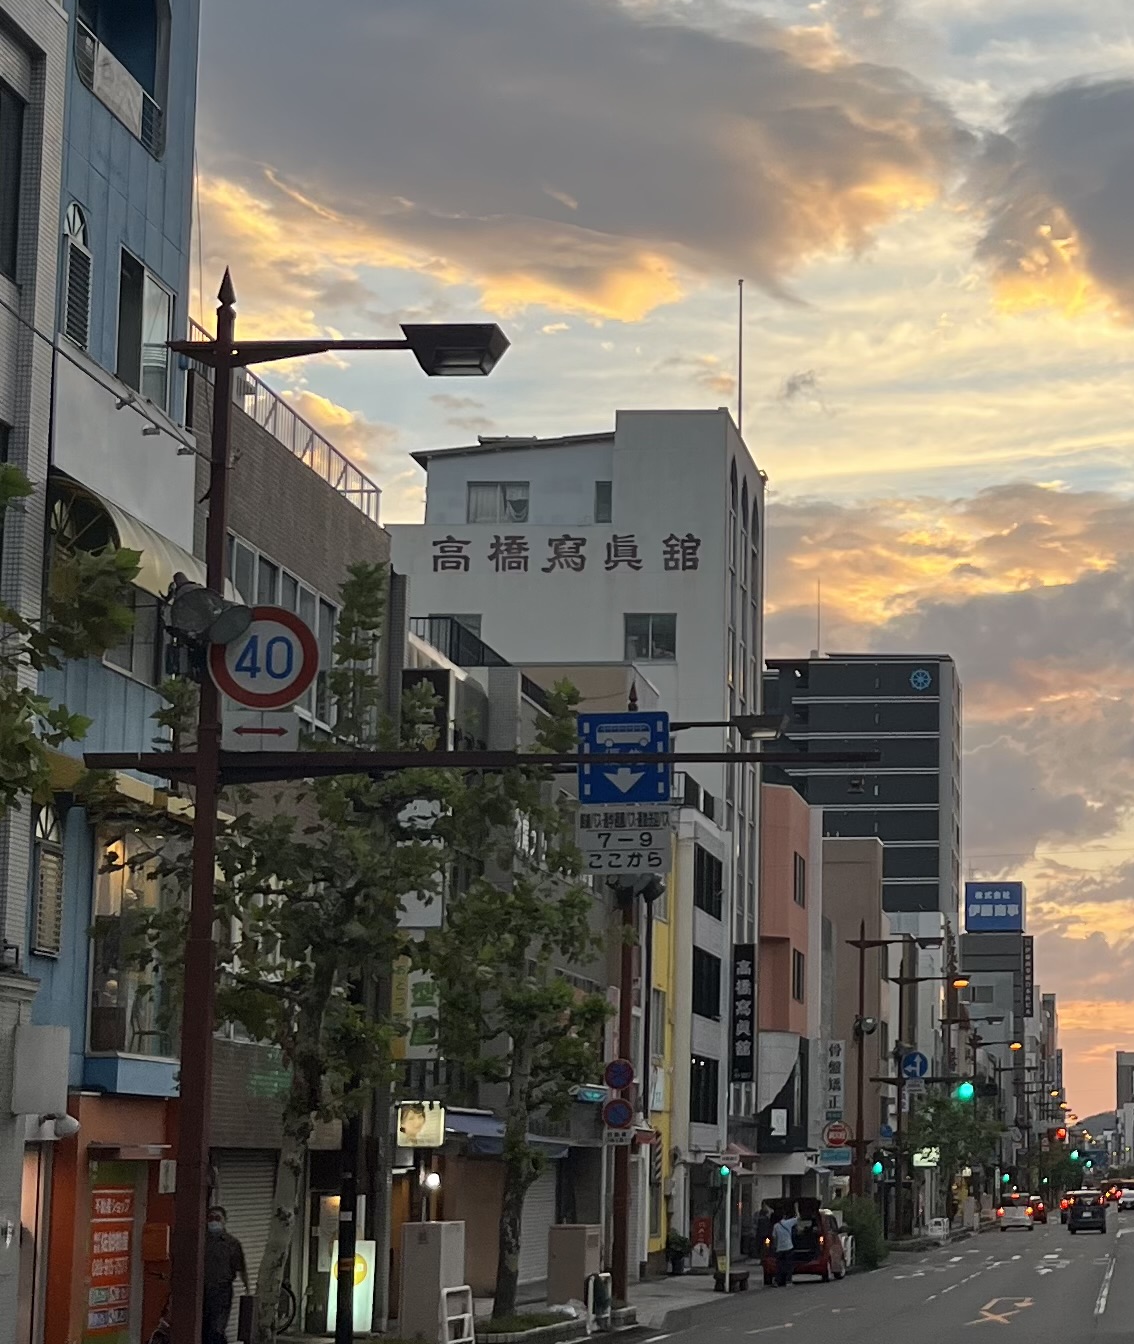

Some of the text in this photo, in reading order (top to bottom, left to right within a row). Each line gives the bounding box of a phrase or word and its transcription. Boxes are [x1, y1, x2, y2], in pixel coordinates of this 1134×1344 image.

[432, 534, 702, 573] 高橋寫眞館
[235, 635, 294, 679] 40
[588, 852, 663, 869] ここから
